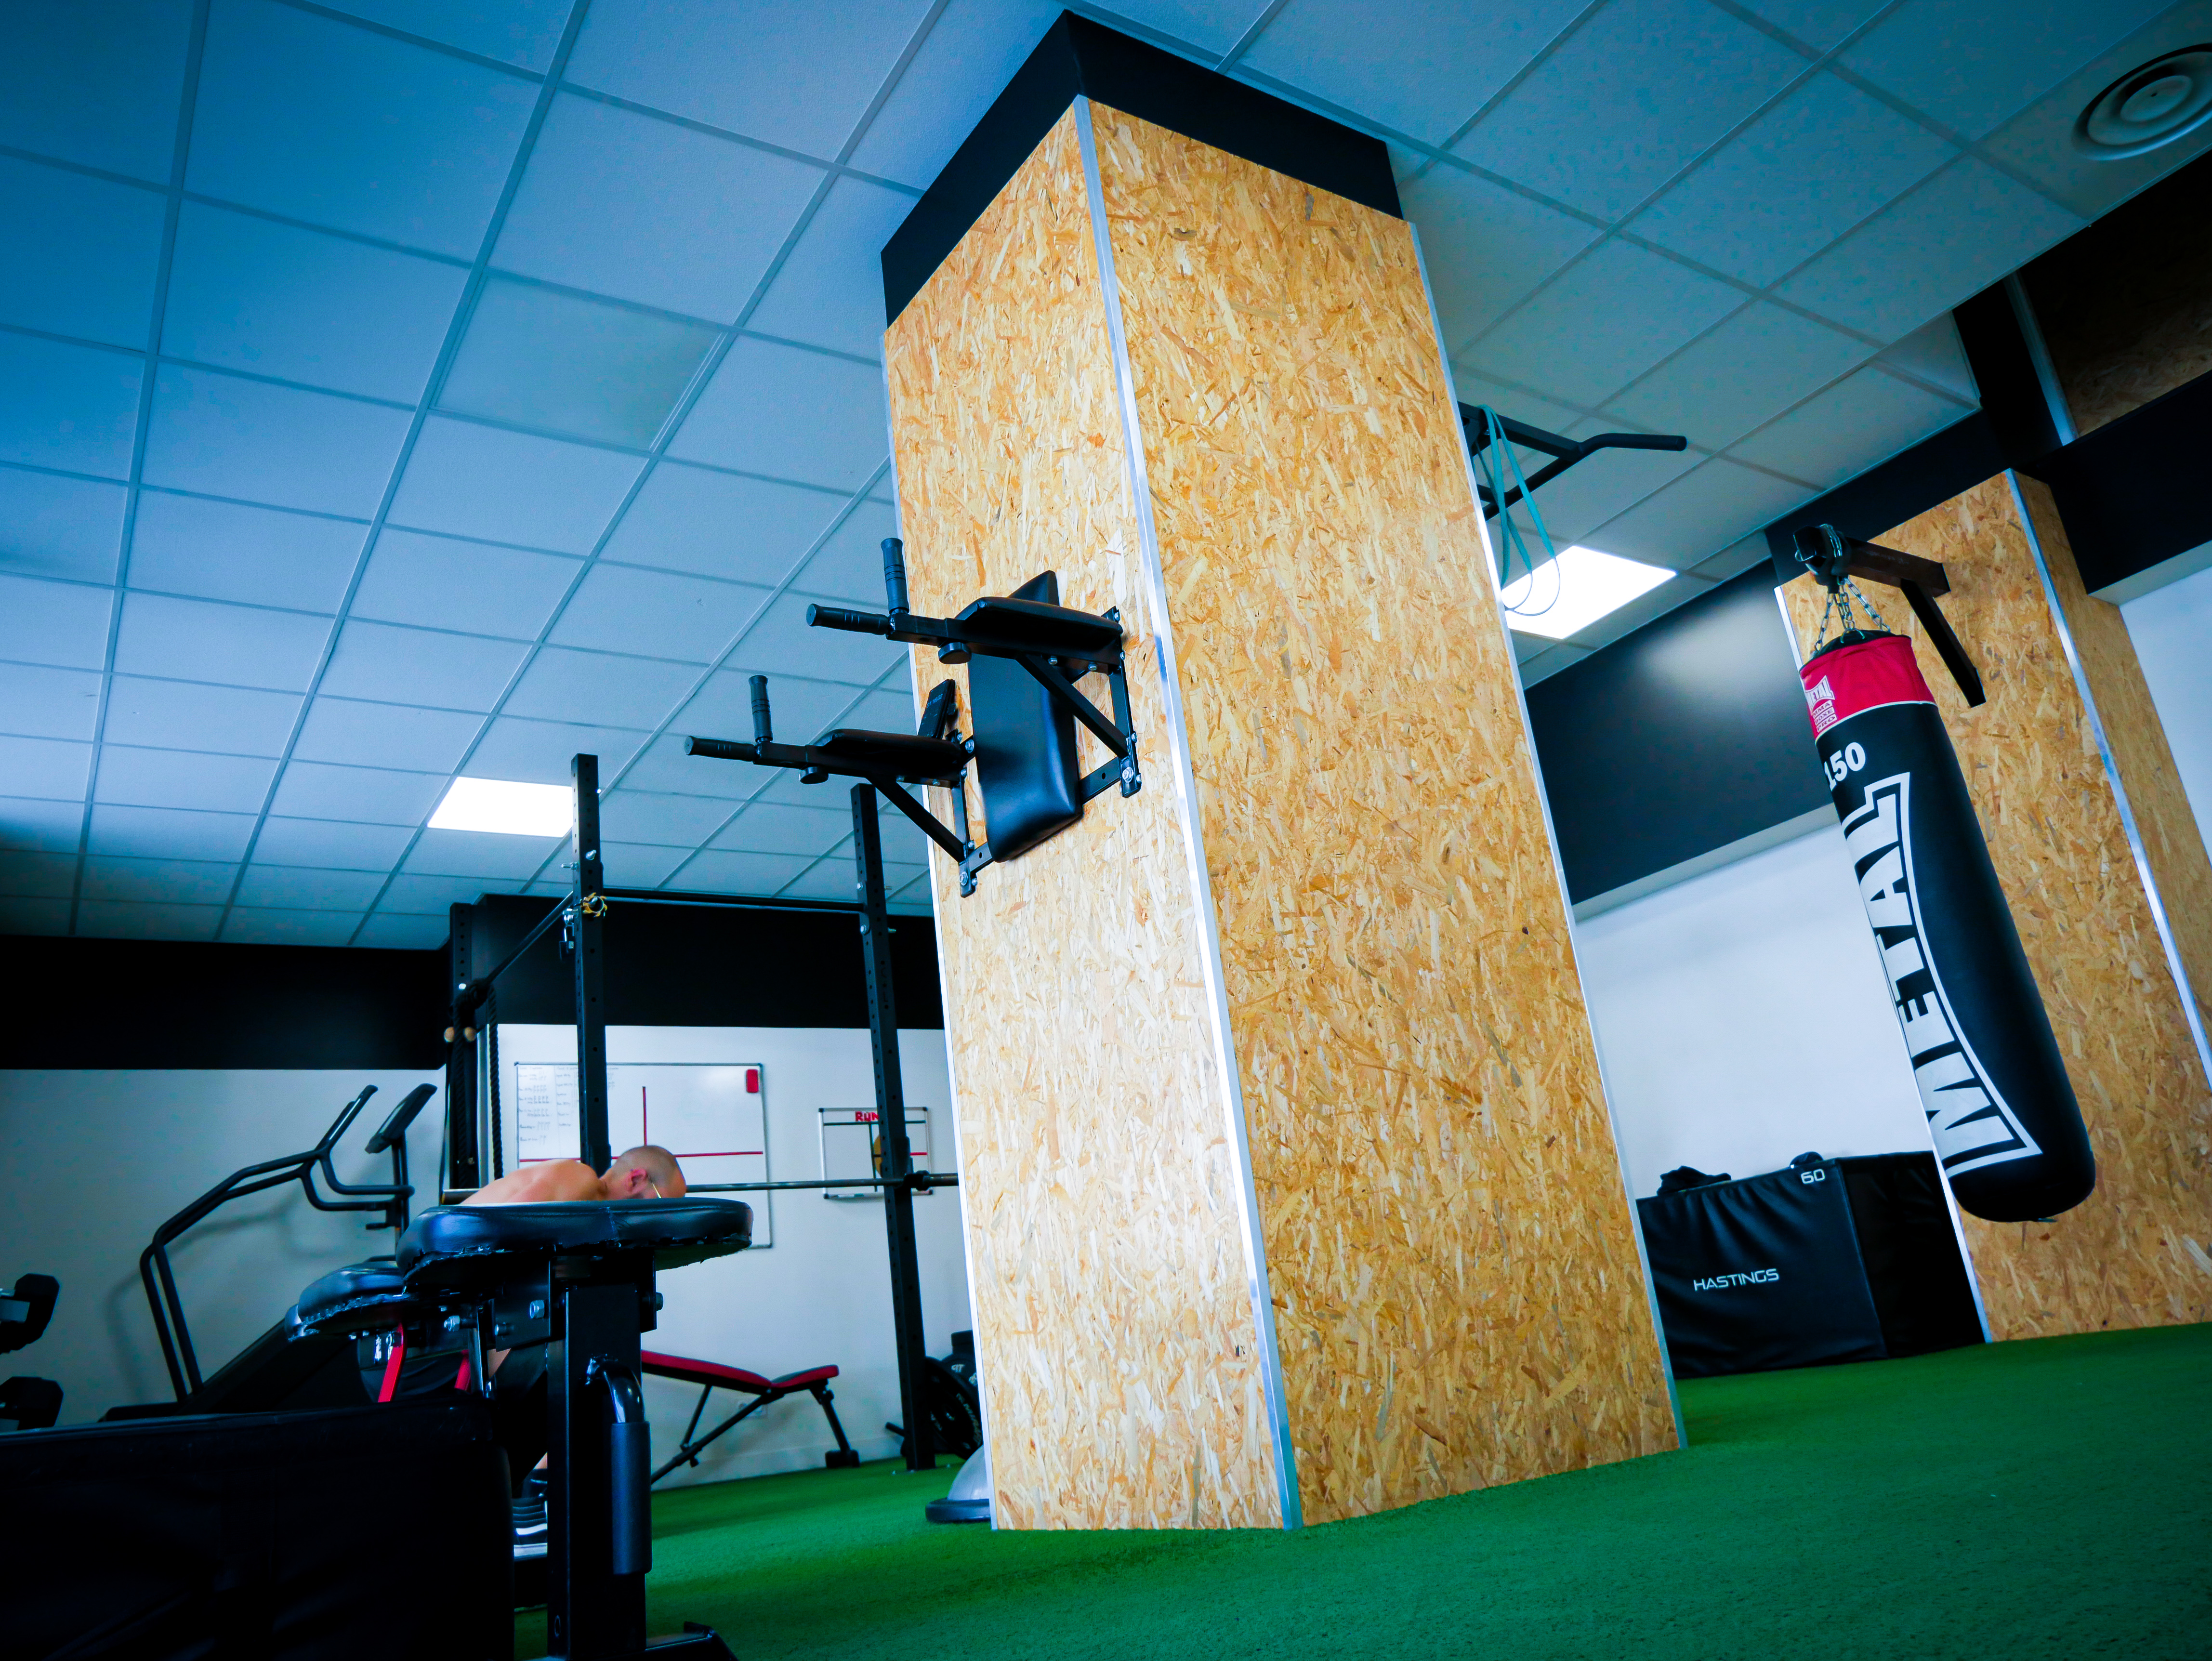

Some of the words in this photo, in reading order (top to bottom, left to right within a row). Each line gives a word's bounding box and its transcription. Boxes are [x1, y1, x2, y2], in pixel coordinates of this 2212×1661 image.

[1815, 710, 1833, 724] BOXE
[1817, 716, 1835, 731] PRO
[1845, 793, 2014, 1159] METAL
[1801, 1169, 1826, 1184] 60
[1693, 1268, 1779, 1292] HASTINGS
